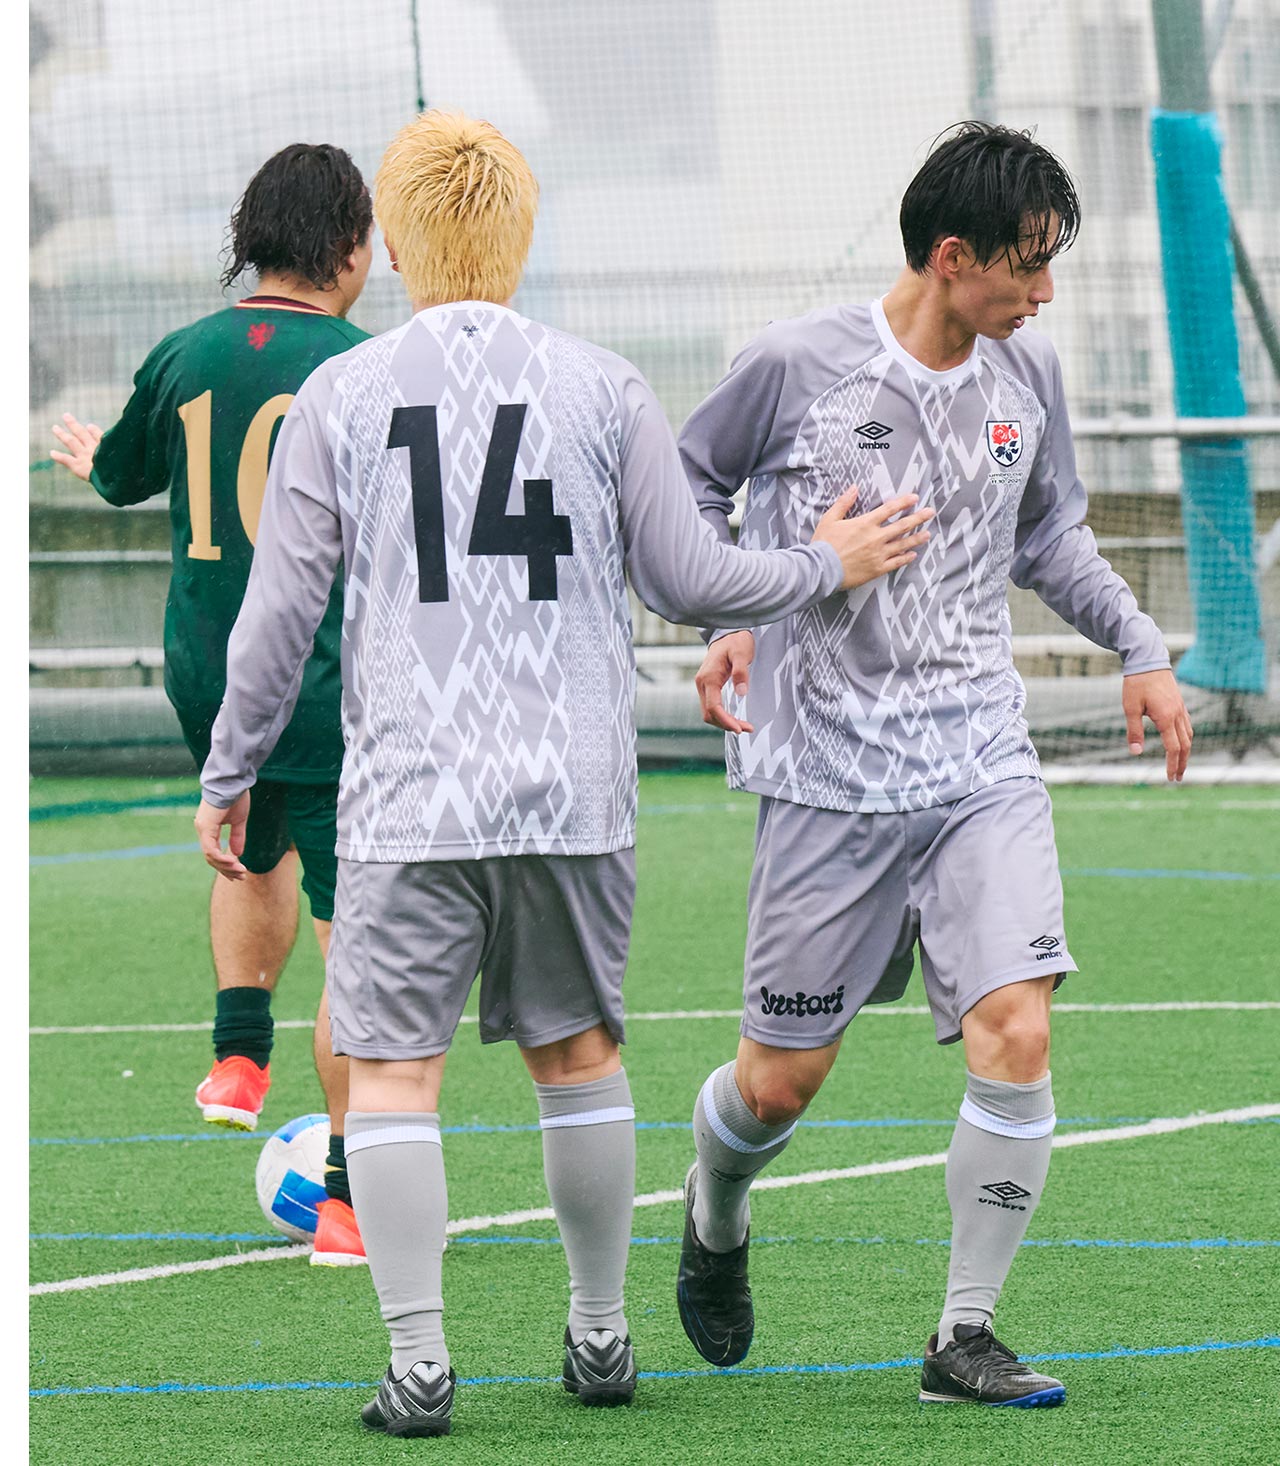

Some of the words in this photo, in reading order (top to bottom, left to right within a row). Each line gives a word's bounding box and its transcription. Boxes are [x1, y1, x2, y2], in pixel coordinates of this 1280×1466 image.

[858, 441, 891, 450] umbro
[386, 403, 574, 603] 14
[978, 1198, 1027, 1211] umbro
